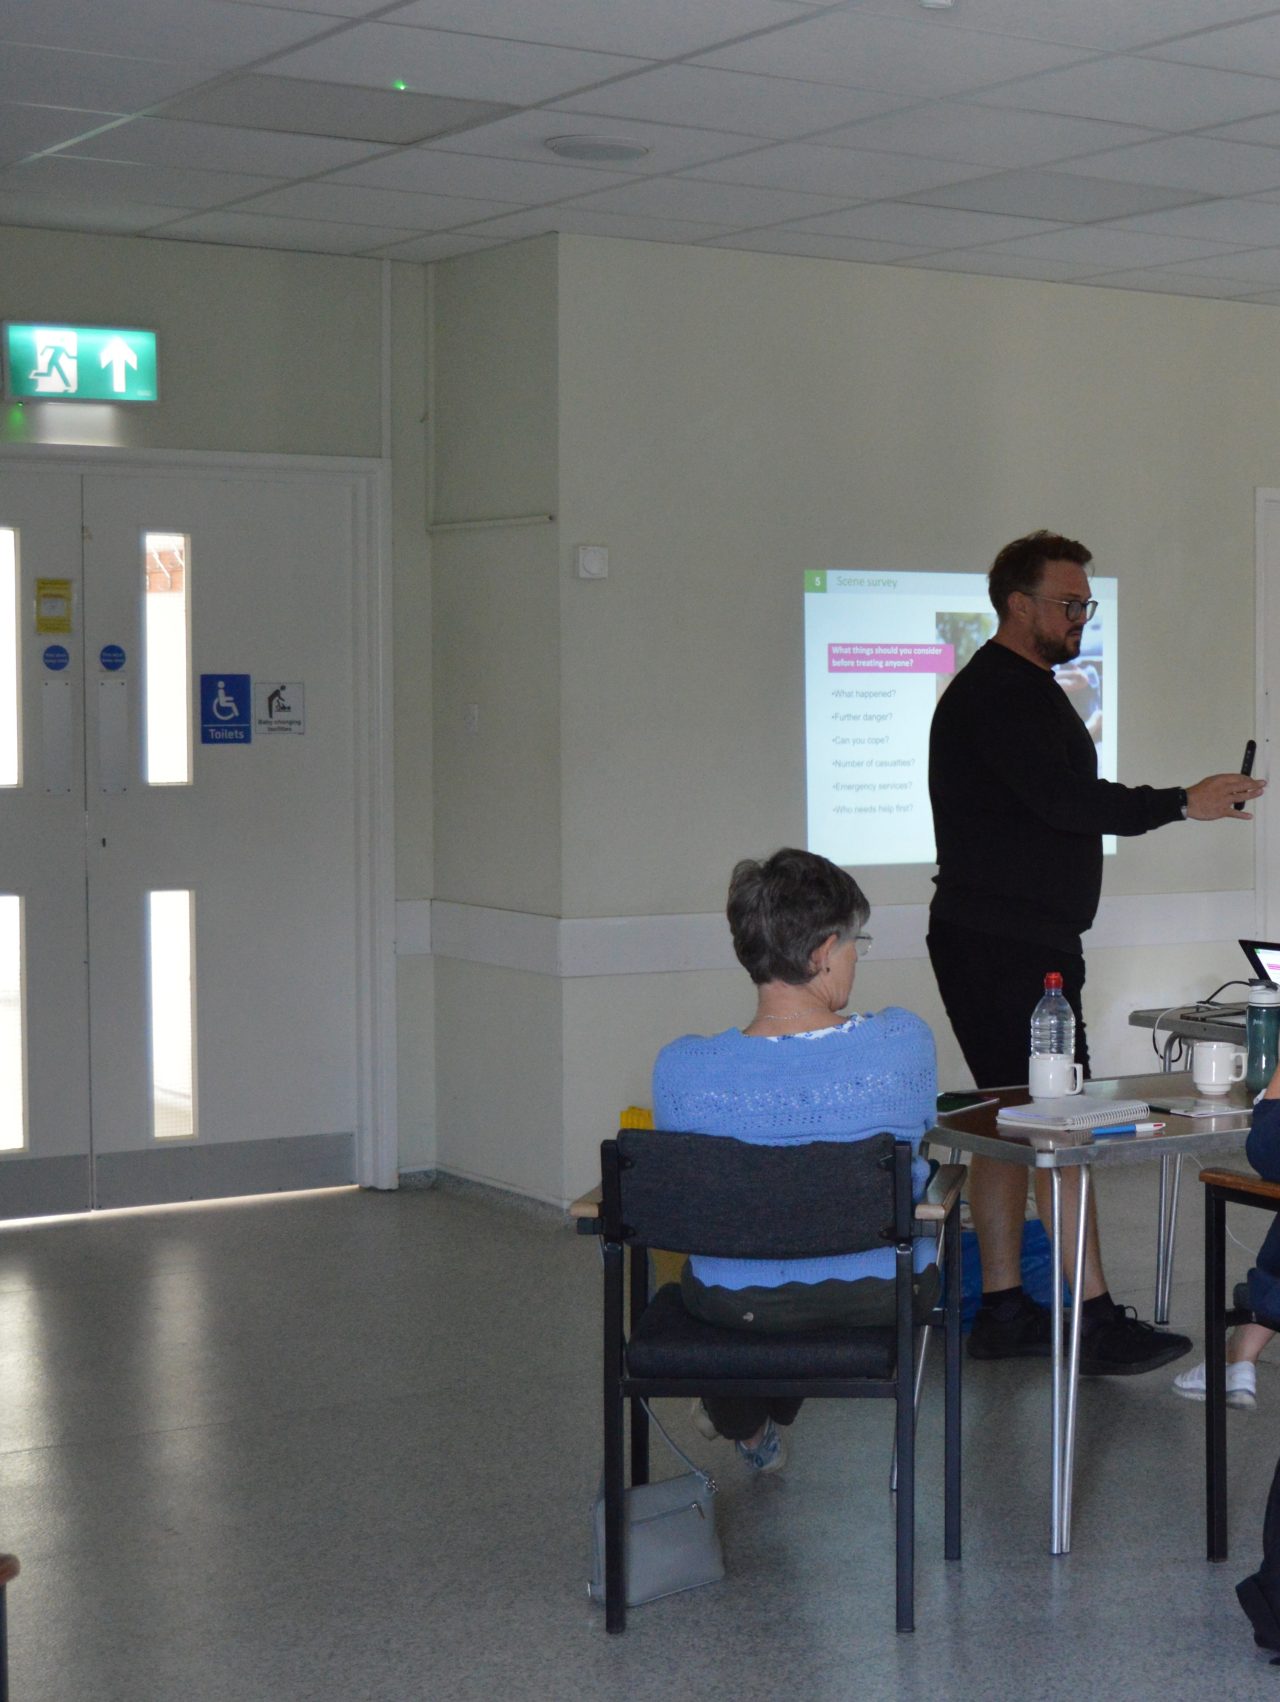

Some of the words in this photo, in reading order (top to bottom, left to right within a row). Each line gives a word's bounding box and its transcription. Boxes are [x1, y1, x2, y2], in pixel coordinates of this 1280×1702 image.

[815, 576, 821, 587] 5
[837, 576, 865, 587] Scene
[867, 577, 898, 590] survey
[832, 646, 851, 655] What
[852, 646, 874, 657] things
[875, 646, 898, 655] should
[899, 648, 912, 657] you
[913, 647, 943, 655] consider
[832, 659, 855, 667] before
[856, 659, 884, 668] treating
[885, 659, 914, 669] anyone?
[855, 688, 897, 699] happened?
[862, 712, 894, 723] danger?
[208, 729, 245, 739] Toilets
[852, 738, 866, 747] you
[867, 735, 890, 746] cope?
[865, 758, 874, 767] of
[875, 758, 916, 768] casualties?
[878, 781, 913, 791] services?
